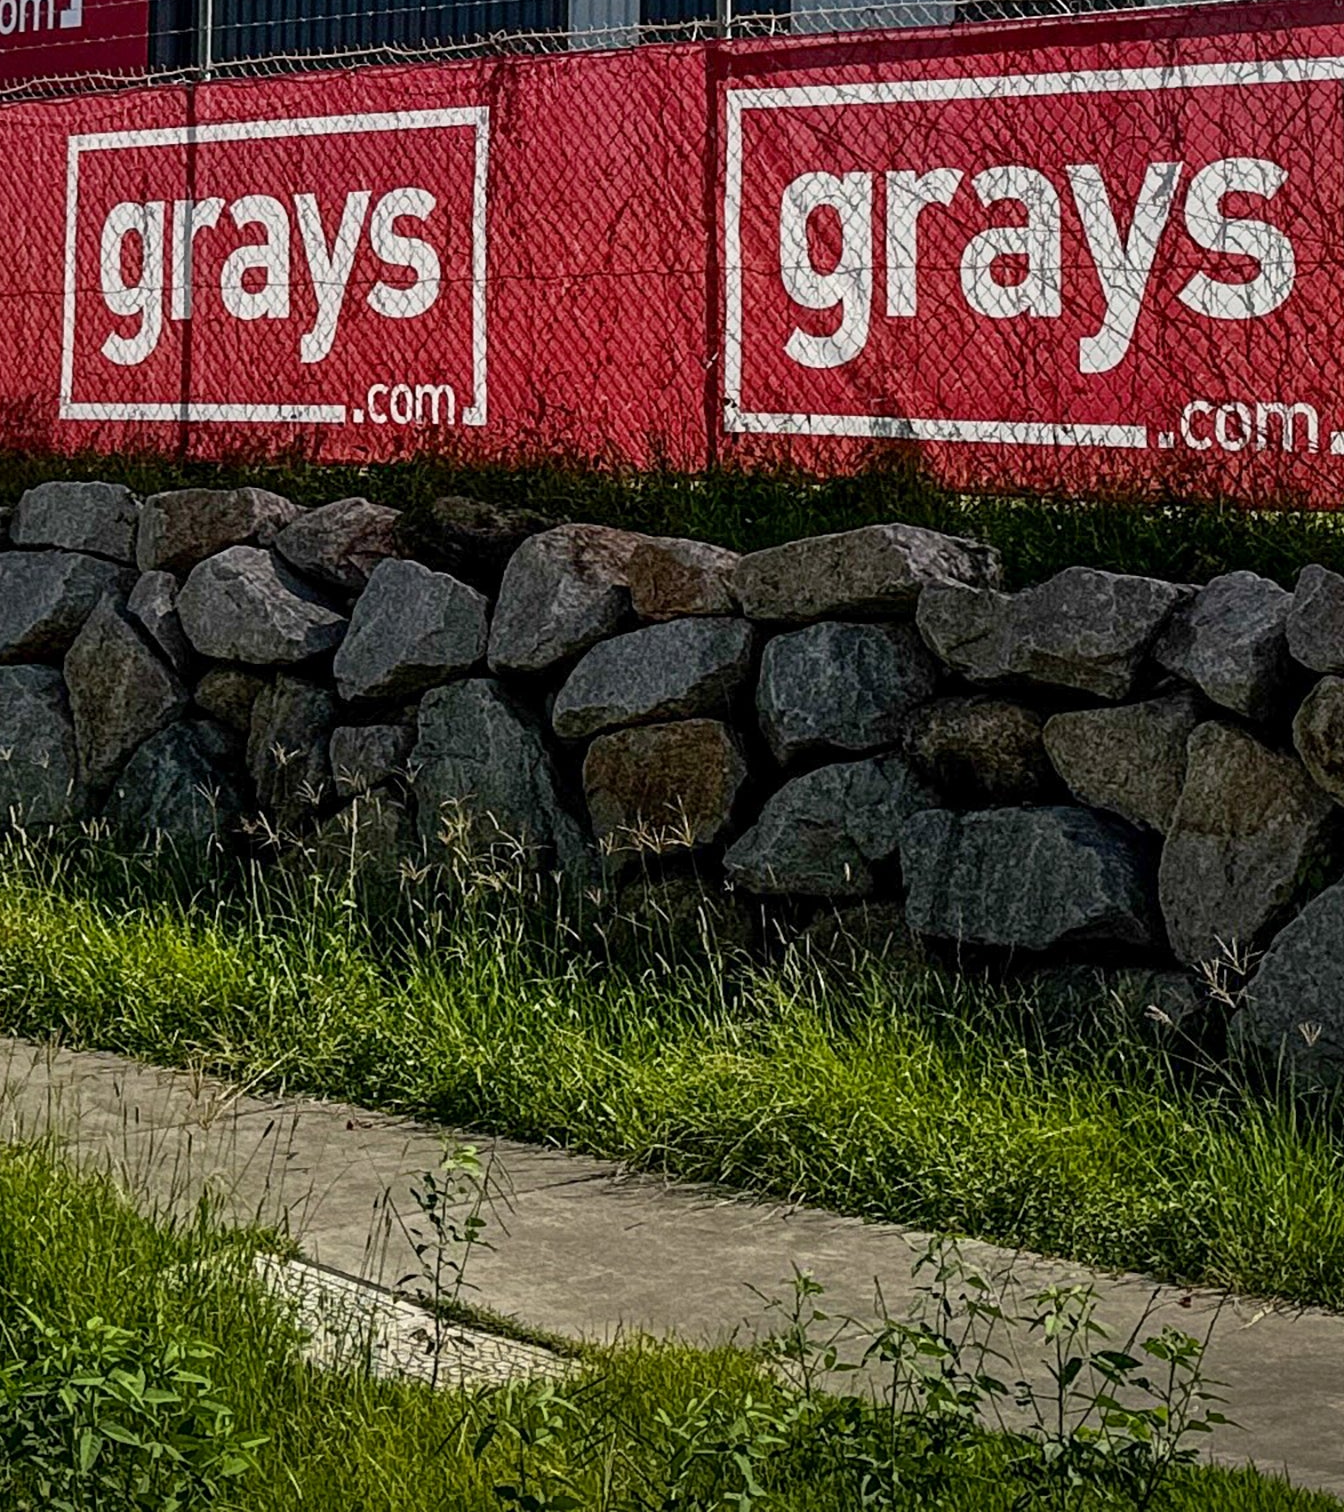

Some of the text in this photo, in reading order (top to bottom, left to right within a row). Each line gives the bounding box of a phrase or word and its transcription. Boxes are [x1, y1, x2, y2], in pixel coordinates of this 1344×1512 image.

[100, 187, 442, 366] grays
[780, 157, 1296, 374] grays
[353, 383, 456, 426] .com
[1158, 397, 1320, 455] .com
